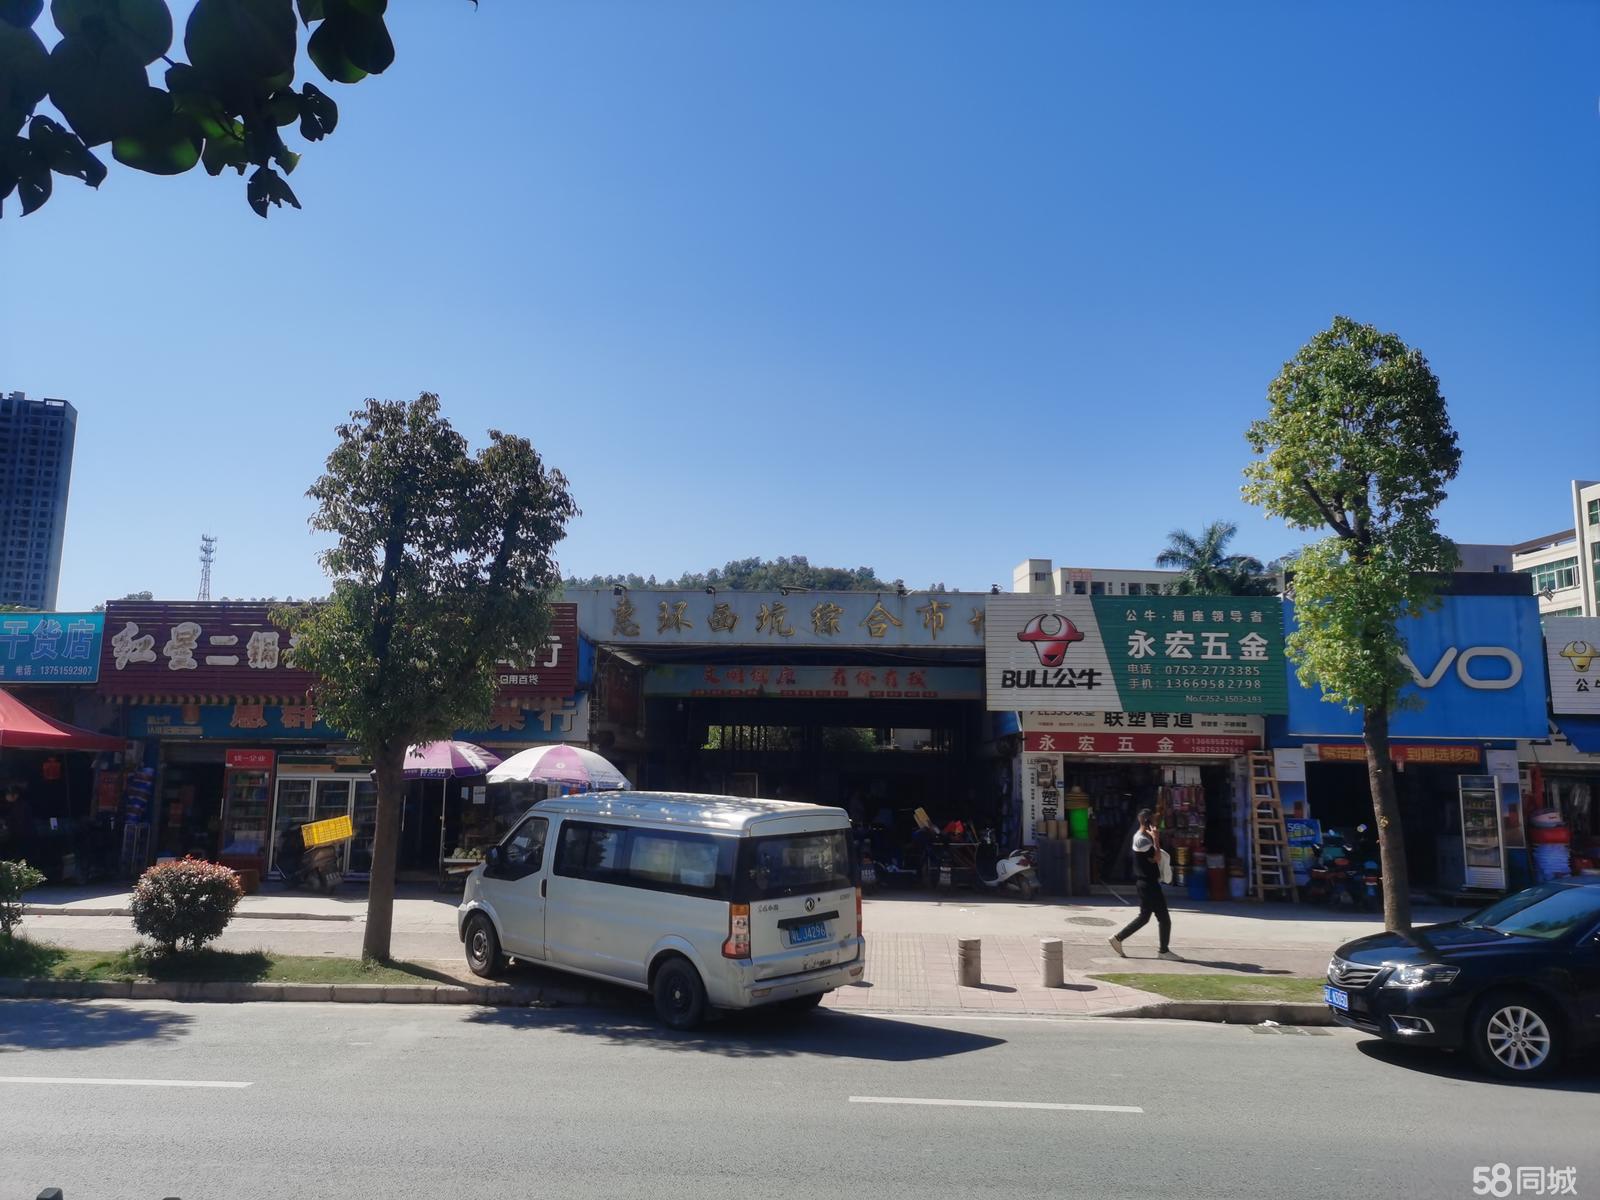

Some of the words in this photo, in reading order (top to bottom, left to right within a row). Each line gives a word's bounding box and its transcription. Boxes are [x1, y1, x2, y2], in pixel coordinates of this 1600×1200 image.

[0, 619, 96, 660] 干货店
[1128, 629, 1269, 660] 永宏五金
[1166, 679, 1261, 689] 13669582798
[1103, 711, 1194, 728] 联塑管道
[1039, 734, 1175, 753] 永宏五金
